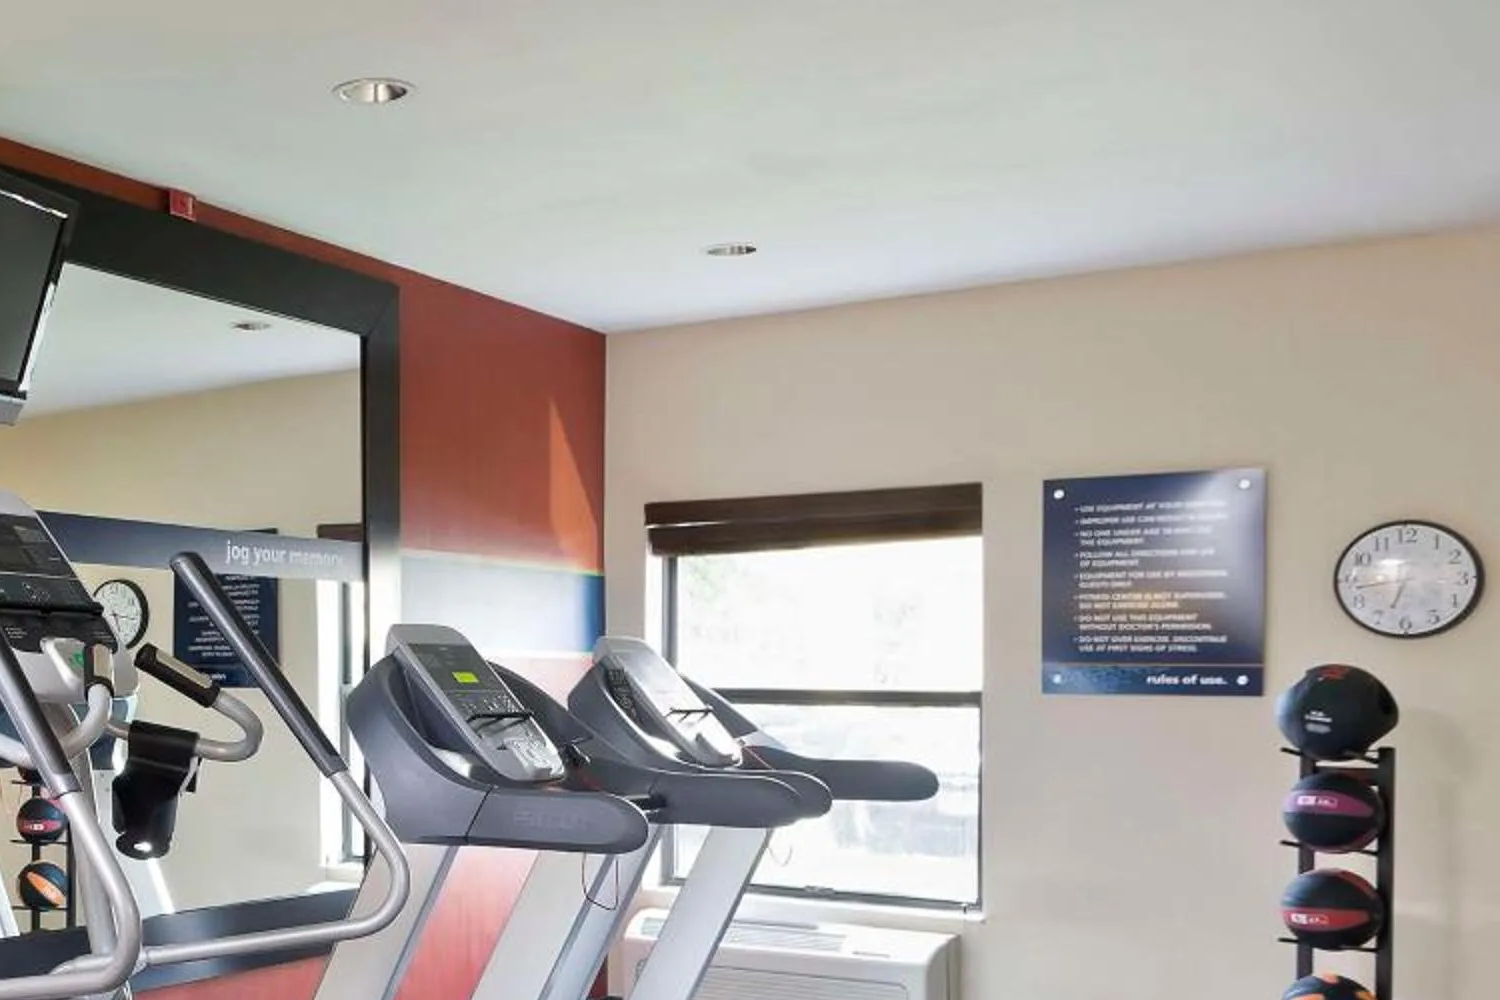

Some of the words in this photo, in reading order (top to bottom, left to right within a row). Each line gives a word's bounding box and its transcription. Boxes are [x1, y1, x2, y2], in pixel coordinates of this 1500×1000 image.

[1396, 528, 1418, 543] 12
[1374, 536, 1389, 551] 11
[225, 540, 250, 565] jog
[253, 546, 287, 566] your
[1353, 553, 1371, 567] 10
[1448, 549, 1462, 564] 2
[1399, 616, 1413, 630] 6
[1427, 610, 1441, 625] 5
[1146, 674, 1180, 686] rules
[1181, 673, 1199, 686] of
[1200, 676, 1229, 686] use.
